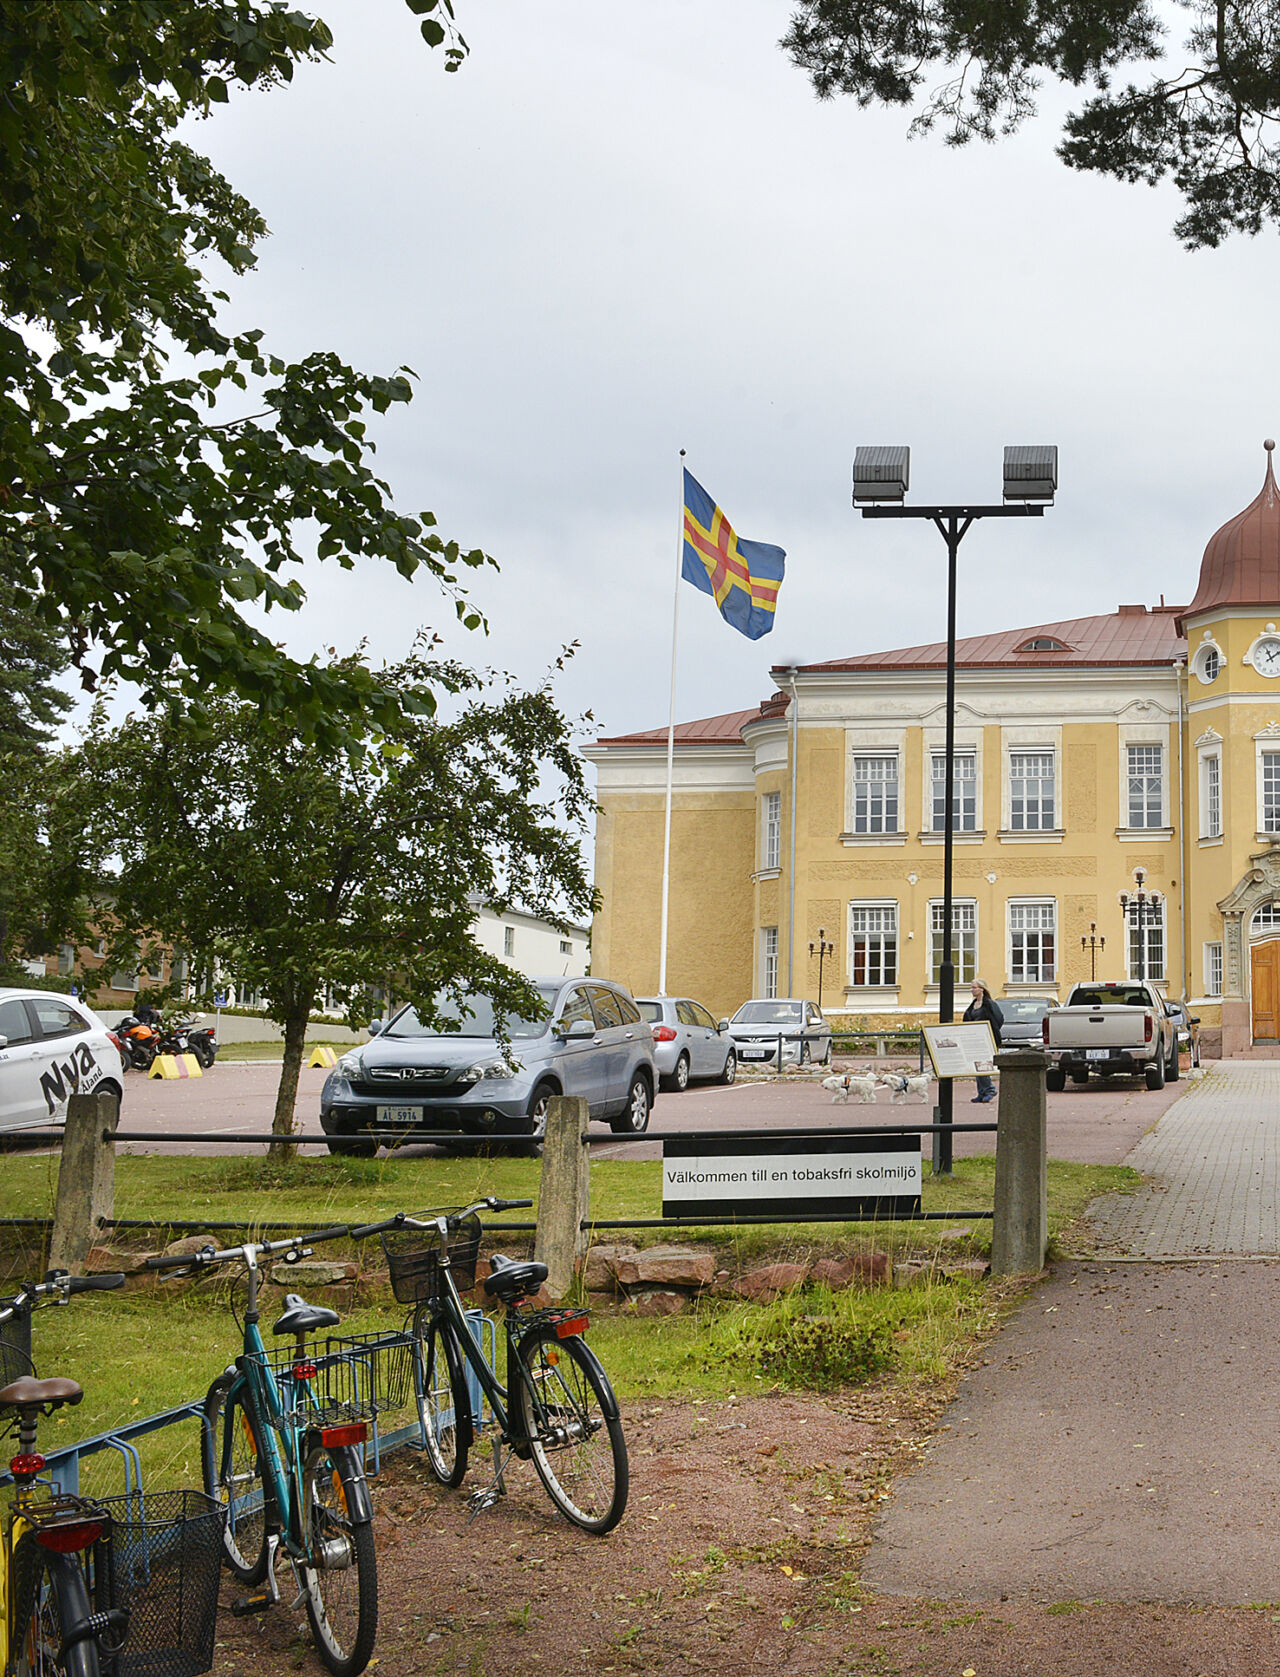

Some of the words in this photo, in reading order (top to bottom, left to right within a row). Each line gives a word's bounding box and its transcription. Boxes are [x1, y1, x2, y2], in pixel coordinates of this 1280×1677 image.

[39, 1042, 97, 1116] Nya
[667, 1171, 748, 1184] Välkommen
[752, 1169, 768, 1182] till
[771, 1171, 788, 1181] en
[792, 1167, 852, 1181] tobaksfri
[856, 1166, 917, 1181] skolmiljö
